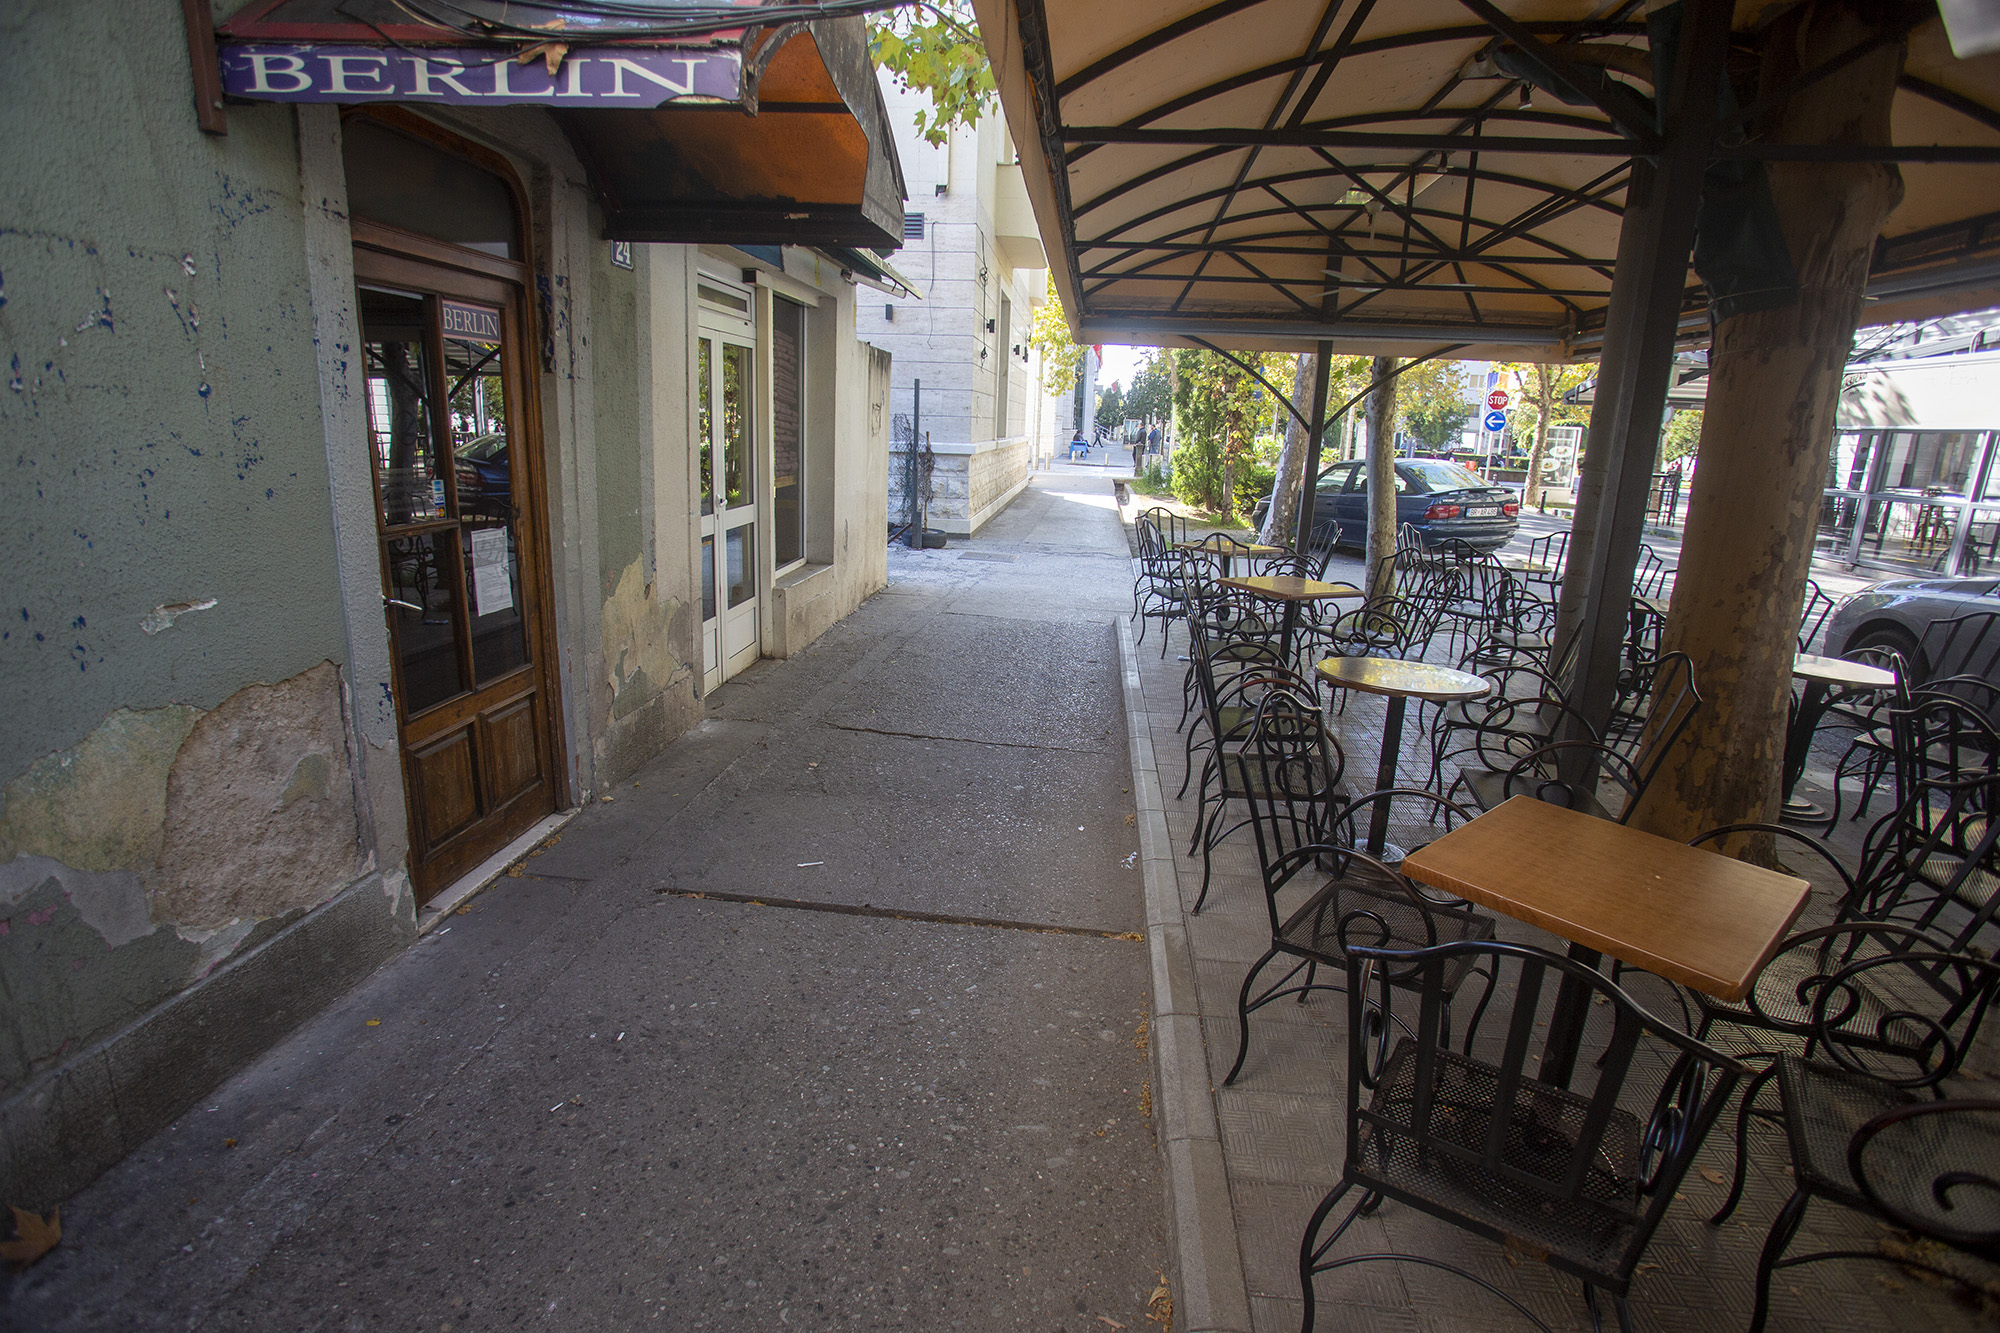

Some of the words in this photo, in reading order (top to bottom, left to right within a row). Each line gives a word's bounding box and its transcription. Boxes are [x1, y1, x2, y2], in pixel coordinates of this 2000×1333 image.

[240, 53, 707, 98] BERLIN
[615, 242, 630, 265] 24
[443, 307, 498, 337] BERLIN
[1489, 395, 1508, 405] STOP
